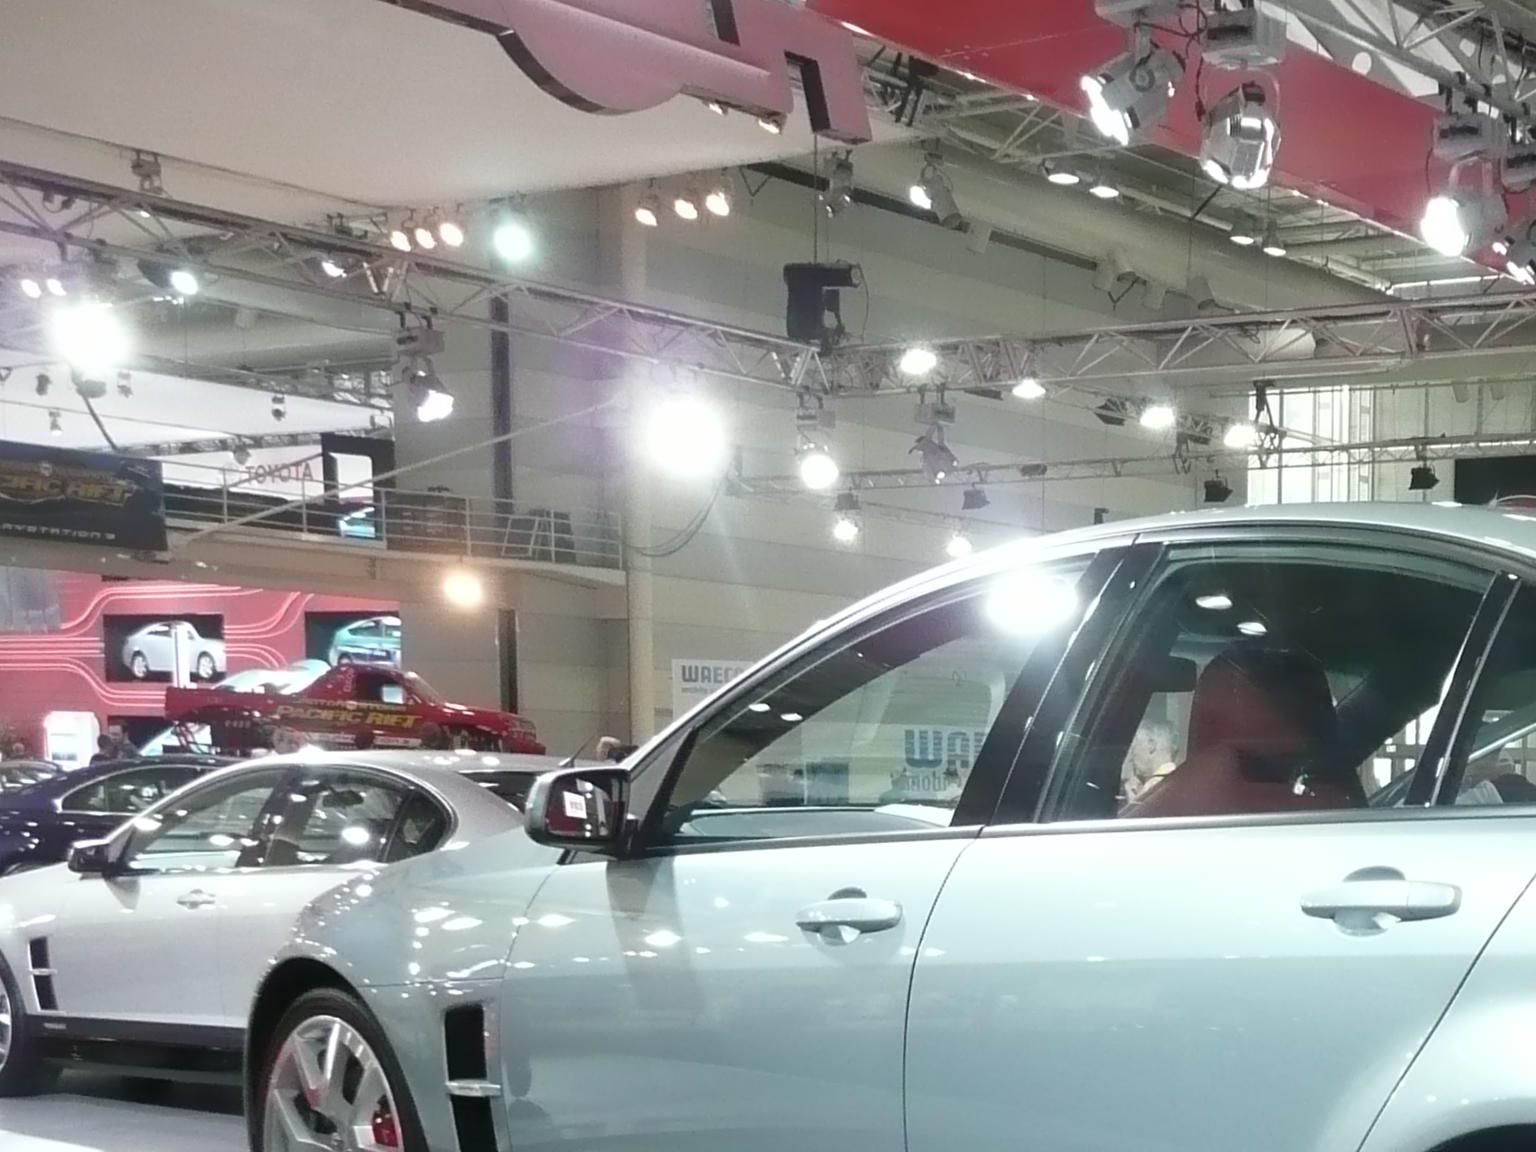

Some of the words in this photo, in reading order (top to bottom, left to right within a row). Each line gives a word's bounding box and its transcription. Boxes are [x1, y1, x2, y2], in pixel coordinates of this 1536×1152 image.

[246, 462, 314, 485] TOYOTA
[277, 705, 364, 722] PACIFIC
[365, 711, 422, 728] RIFT
